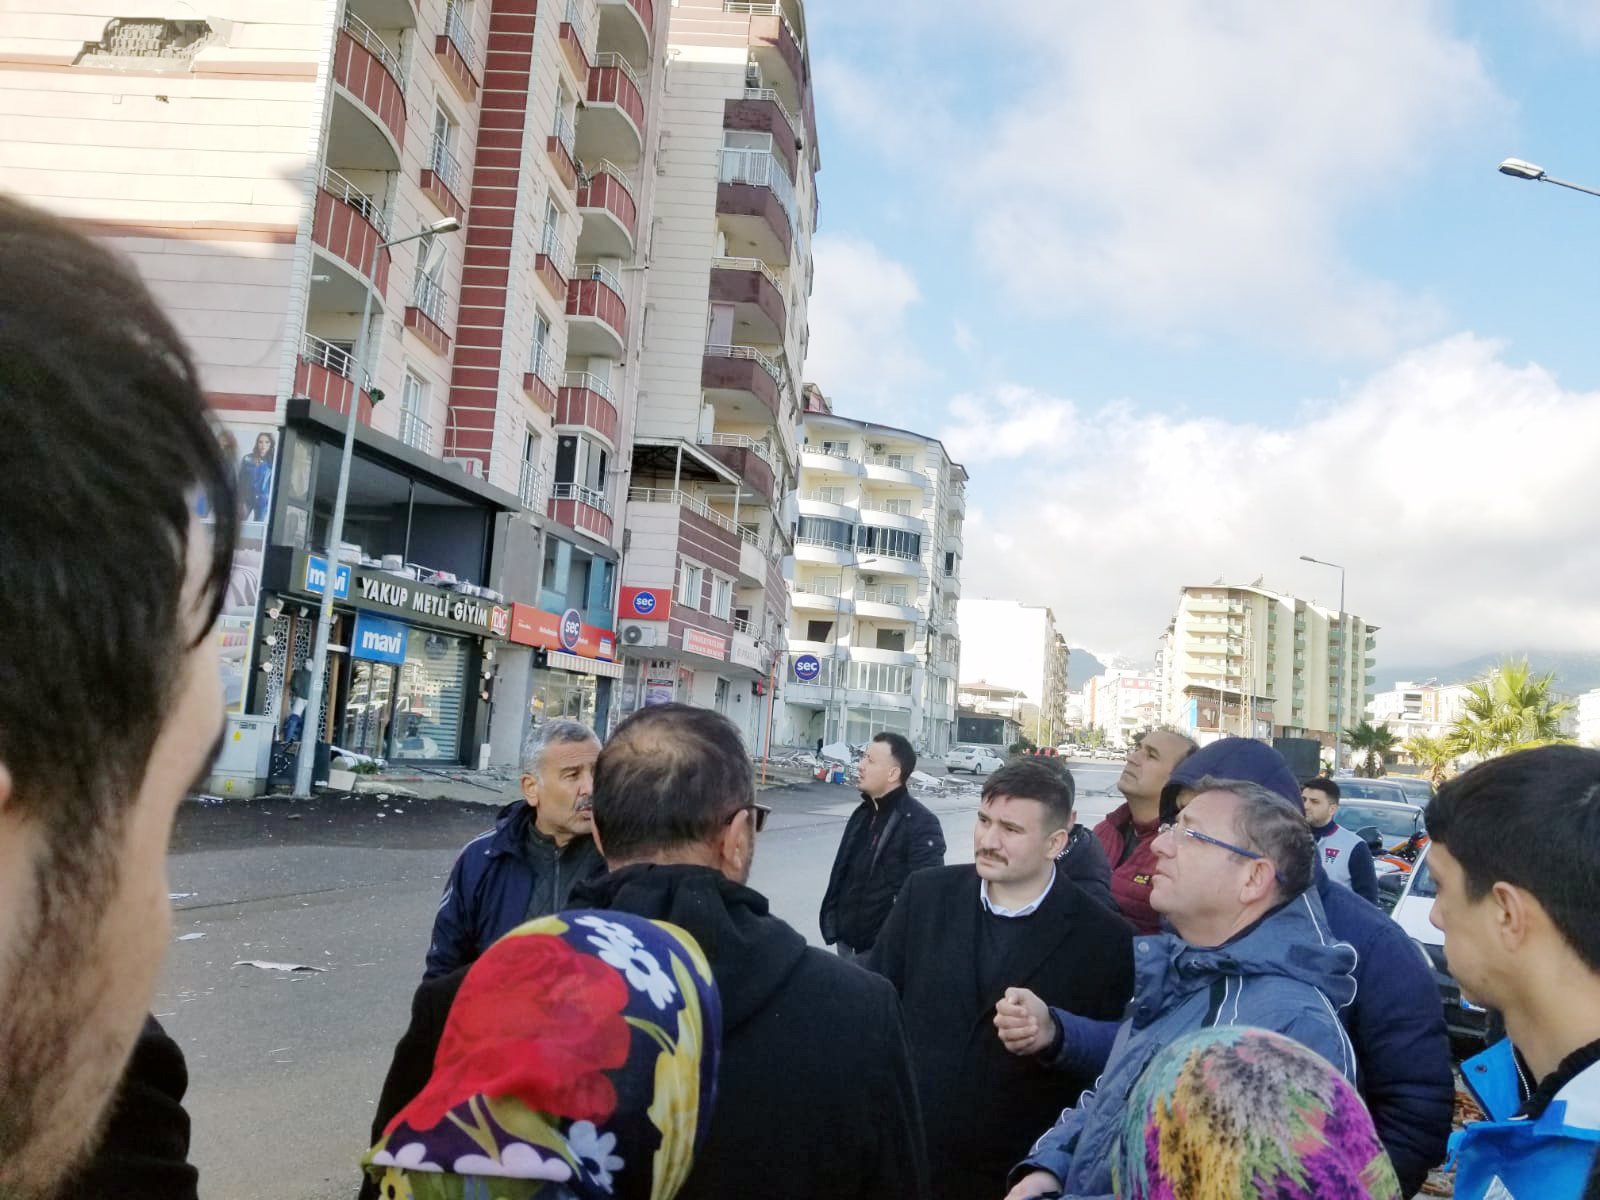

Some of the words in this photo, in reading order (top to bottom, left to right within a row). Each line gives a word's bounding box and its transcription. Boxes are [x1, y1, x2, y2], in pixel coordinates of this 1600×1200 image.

[309, 567, 346, 592] mvi
[362, 576, 408, 607] YAKUP
[412, 591, 450, 618] METLİ
[454, 598, 488, 627] GİYİM
[362, 630, 403, 655] mavi
